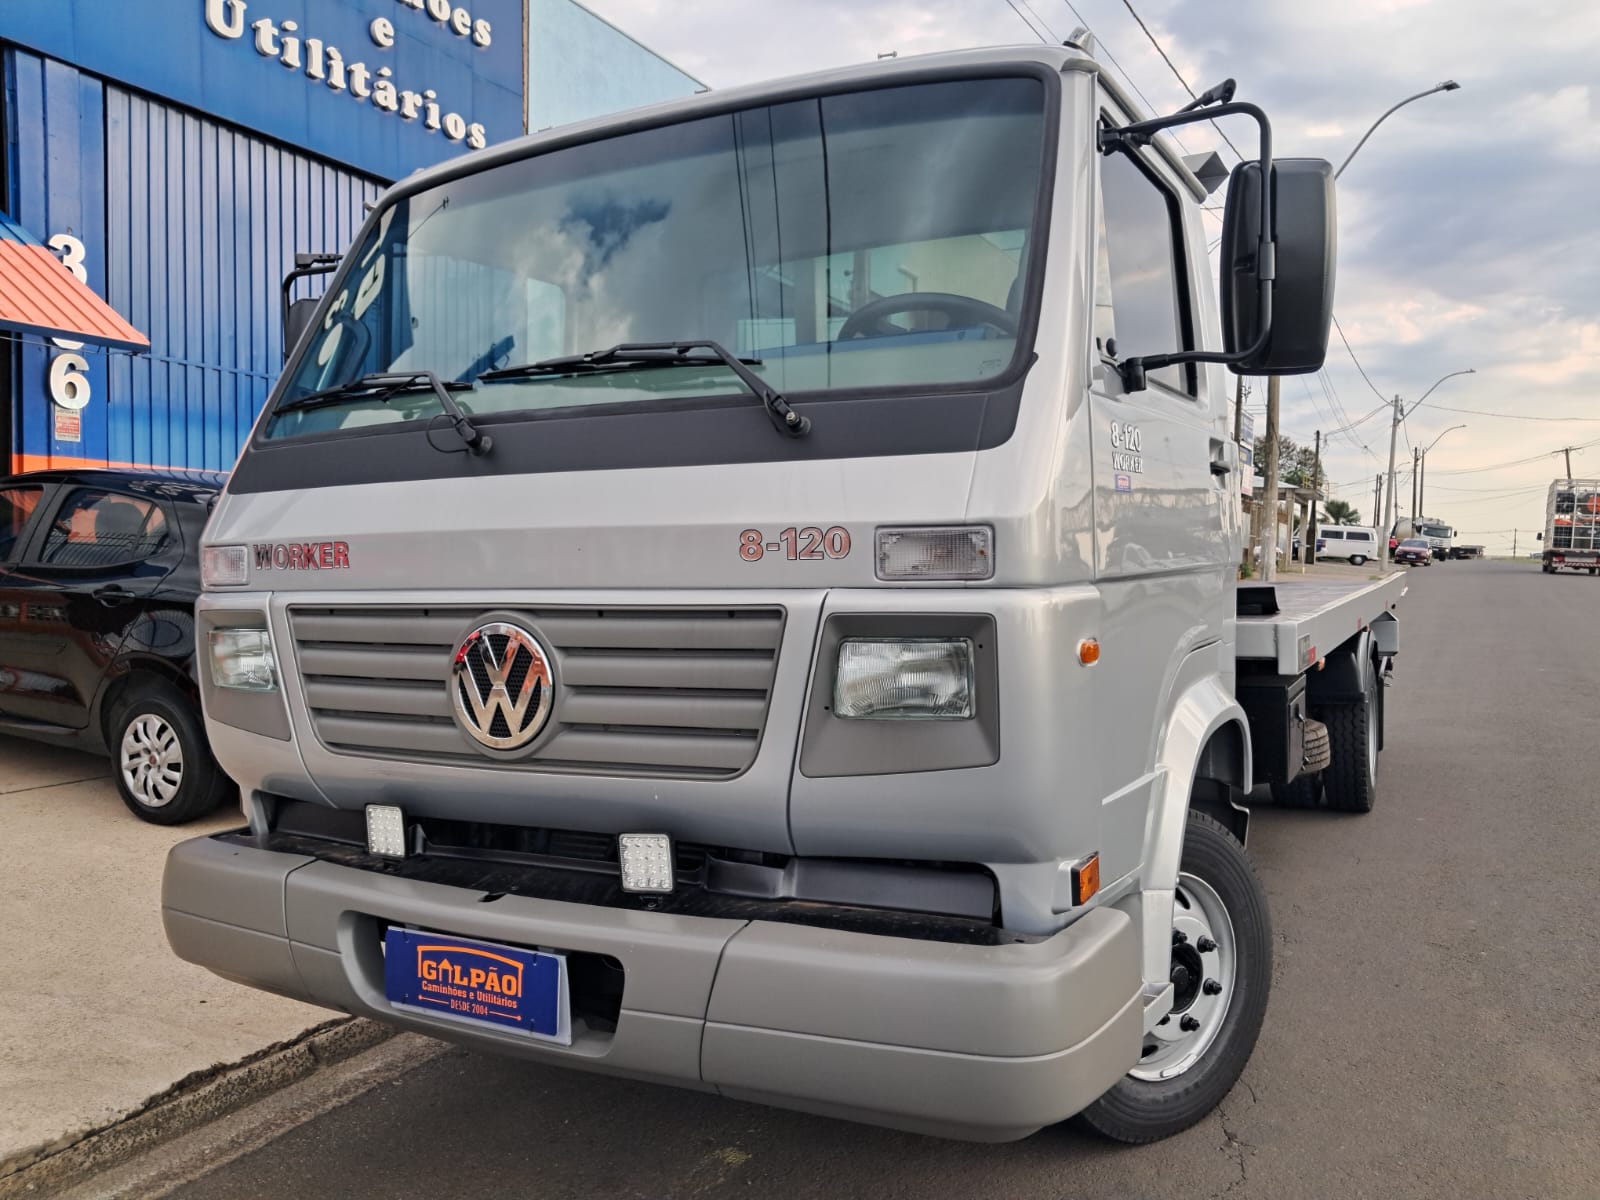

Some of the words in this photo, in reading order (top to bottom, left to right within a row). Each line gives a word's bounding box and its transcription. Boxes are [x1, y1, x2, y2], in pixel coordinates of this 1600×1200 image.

[370, 17, 394, 48] e
[205, 0, 487, 149] Utilitários
[1110, 420, 1142, 452] 8-120
[252, 541, 350, 571] WORKER
[738, 525, 851, 562] 8-120
[450, 998, 471, 1013] DESDE
[471, 1003, 489, 1016] 2004
[469, 991, 475, 1000] e
[477, 991, 518, 1009] Utilitários
